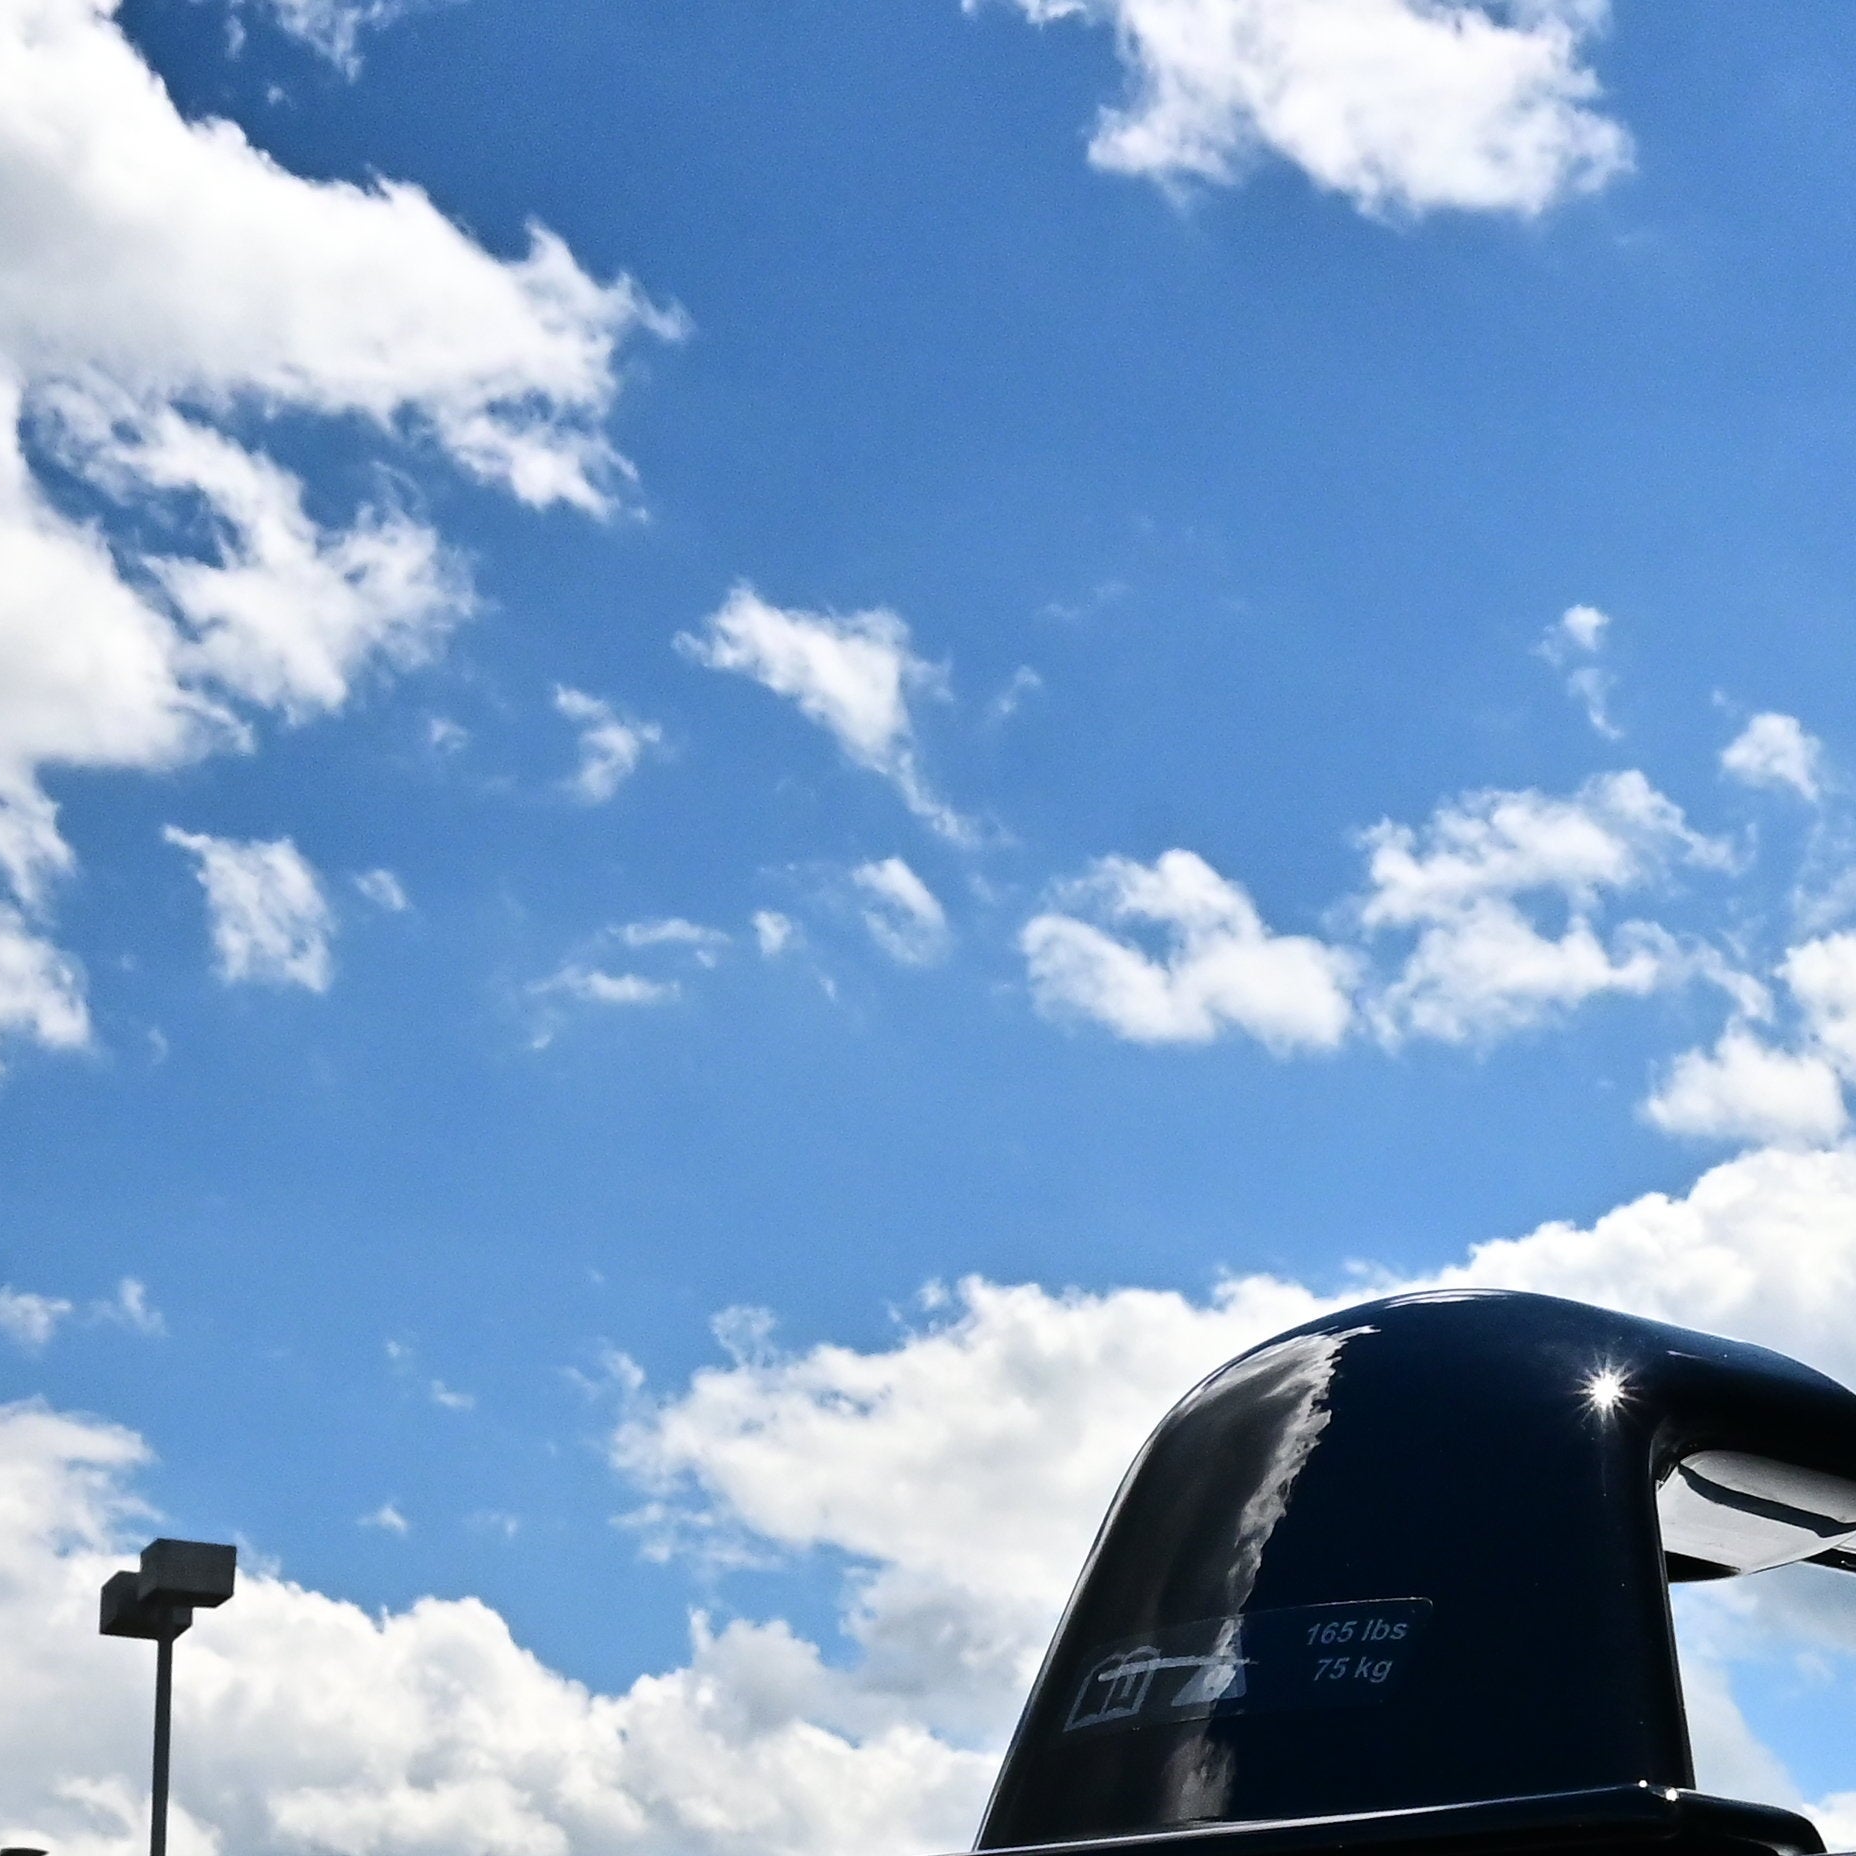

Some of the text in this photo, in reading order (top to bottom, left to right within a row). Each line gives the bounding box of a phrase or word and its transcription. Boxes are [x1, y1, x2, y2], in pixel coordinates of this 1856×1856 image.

[1306, 1618, 1408, 1645] 165 lbs
[1313, 1656, 1393, 1684] 75 kg
